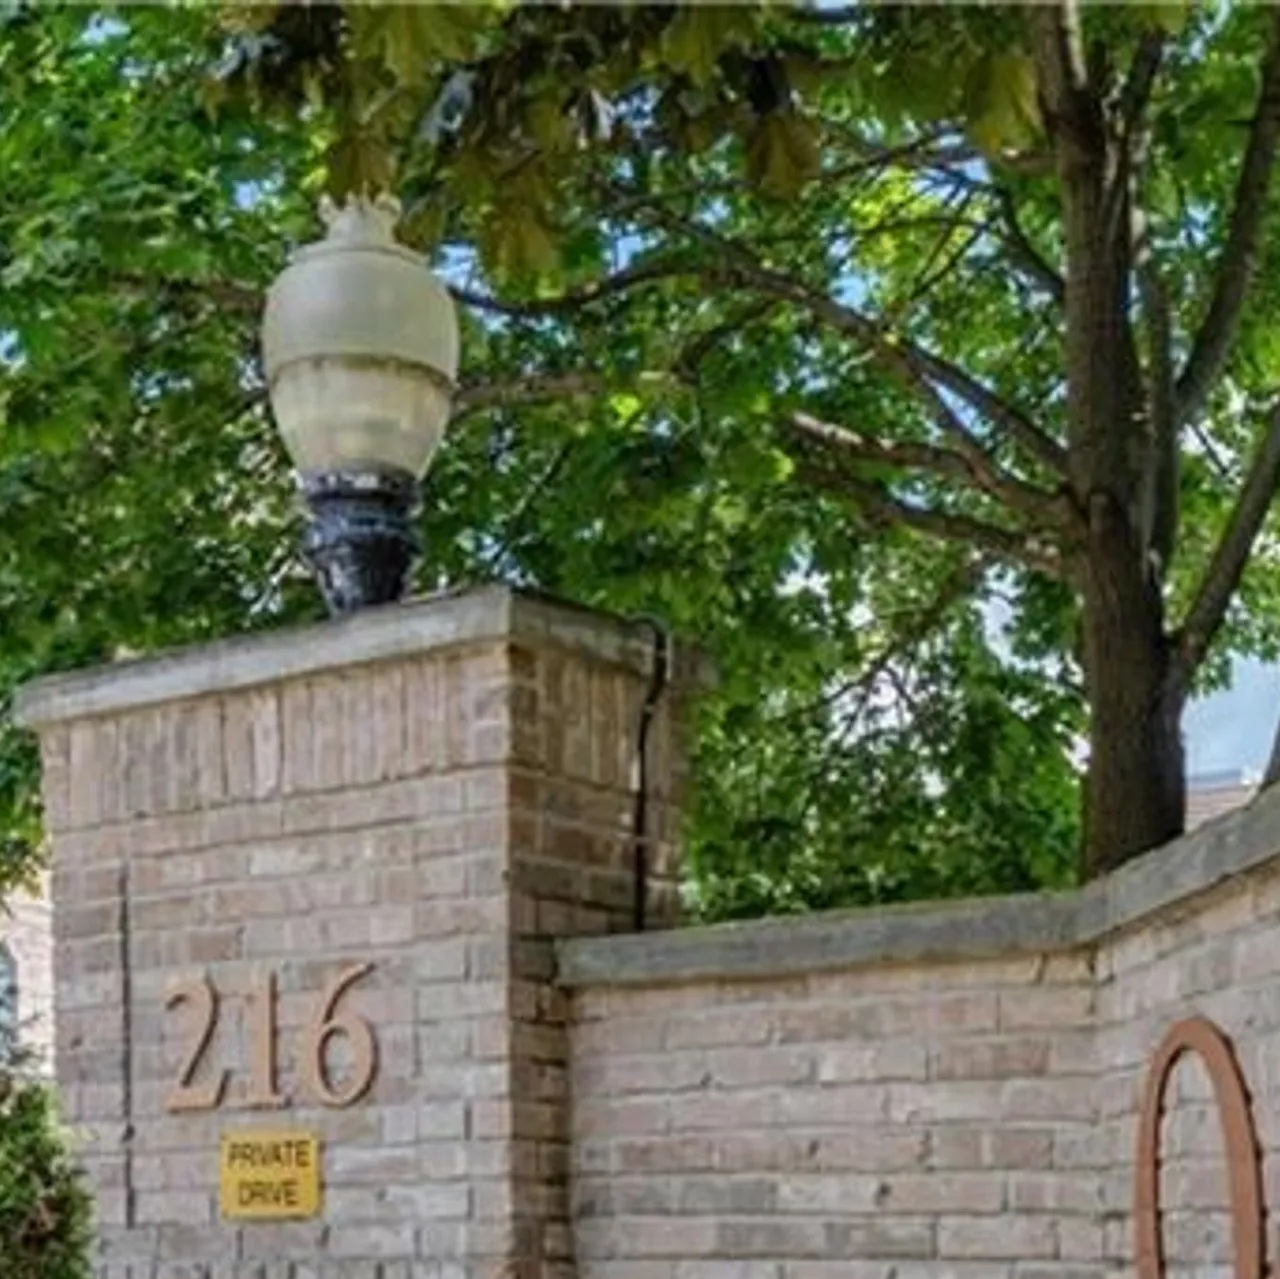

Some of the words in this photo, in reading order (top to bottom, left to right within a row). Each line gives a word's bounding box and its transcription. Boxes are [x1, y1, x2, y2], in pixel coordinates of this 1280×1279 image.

[164, 962, 380, 1113] 216
[228, 1139, 311, 1168] PRIVATE
[238, 1179, 300, 1206] DRIVE
